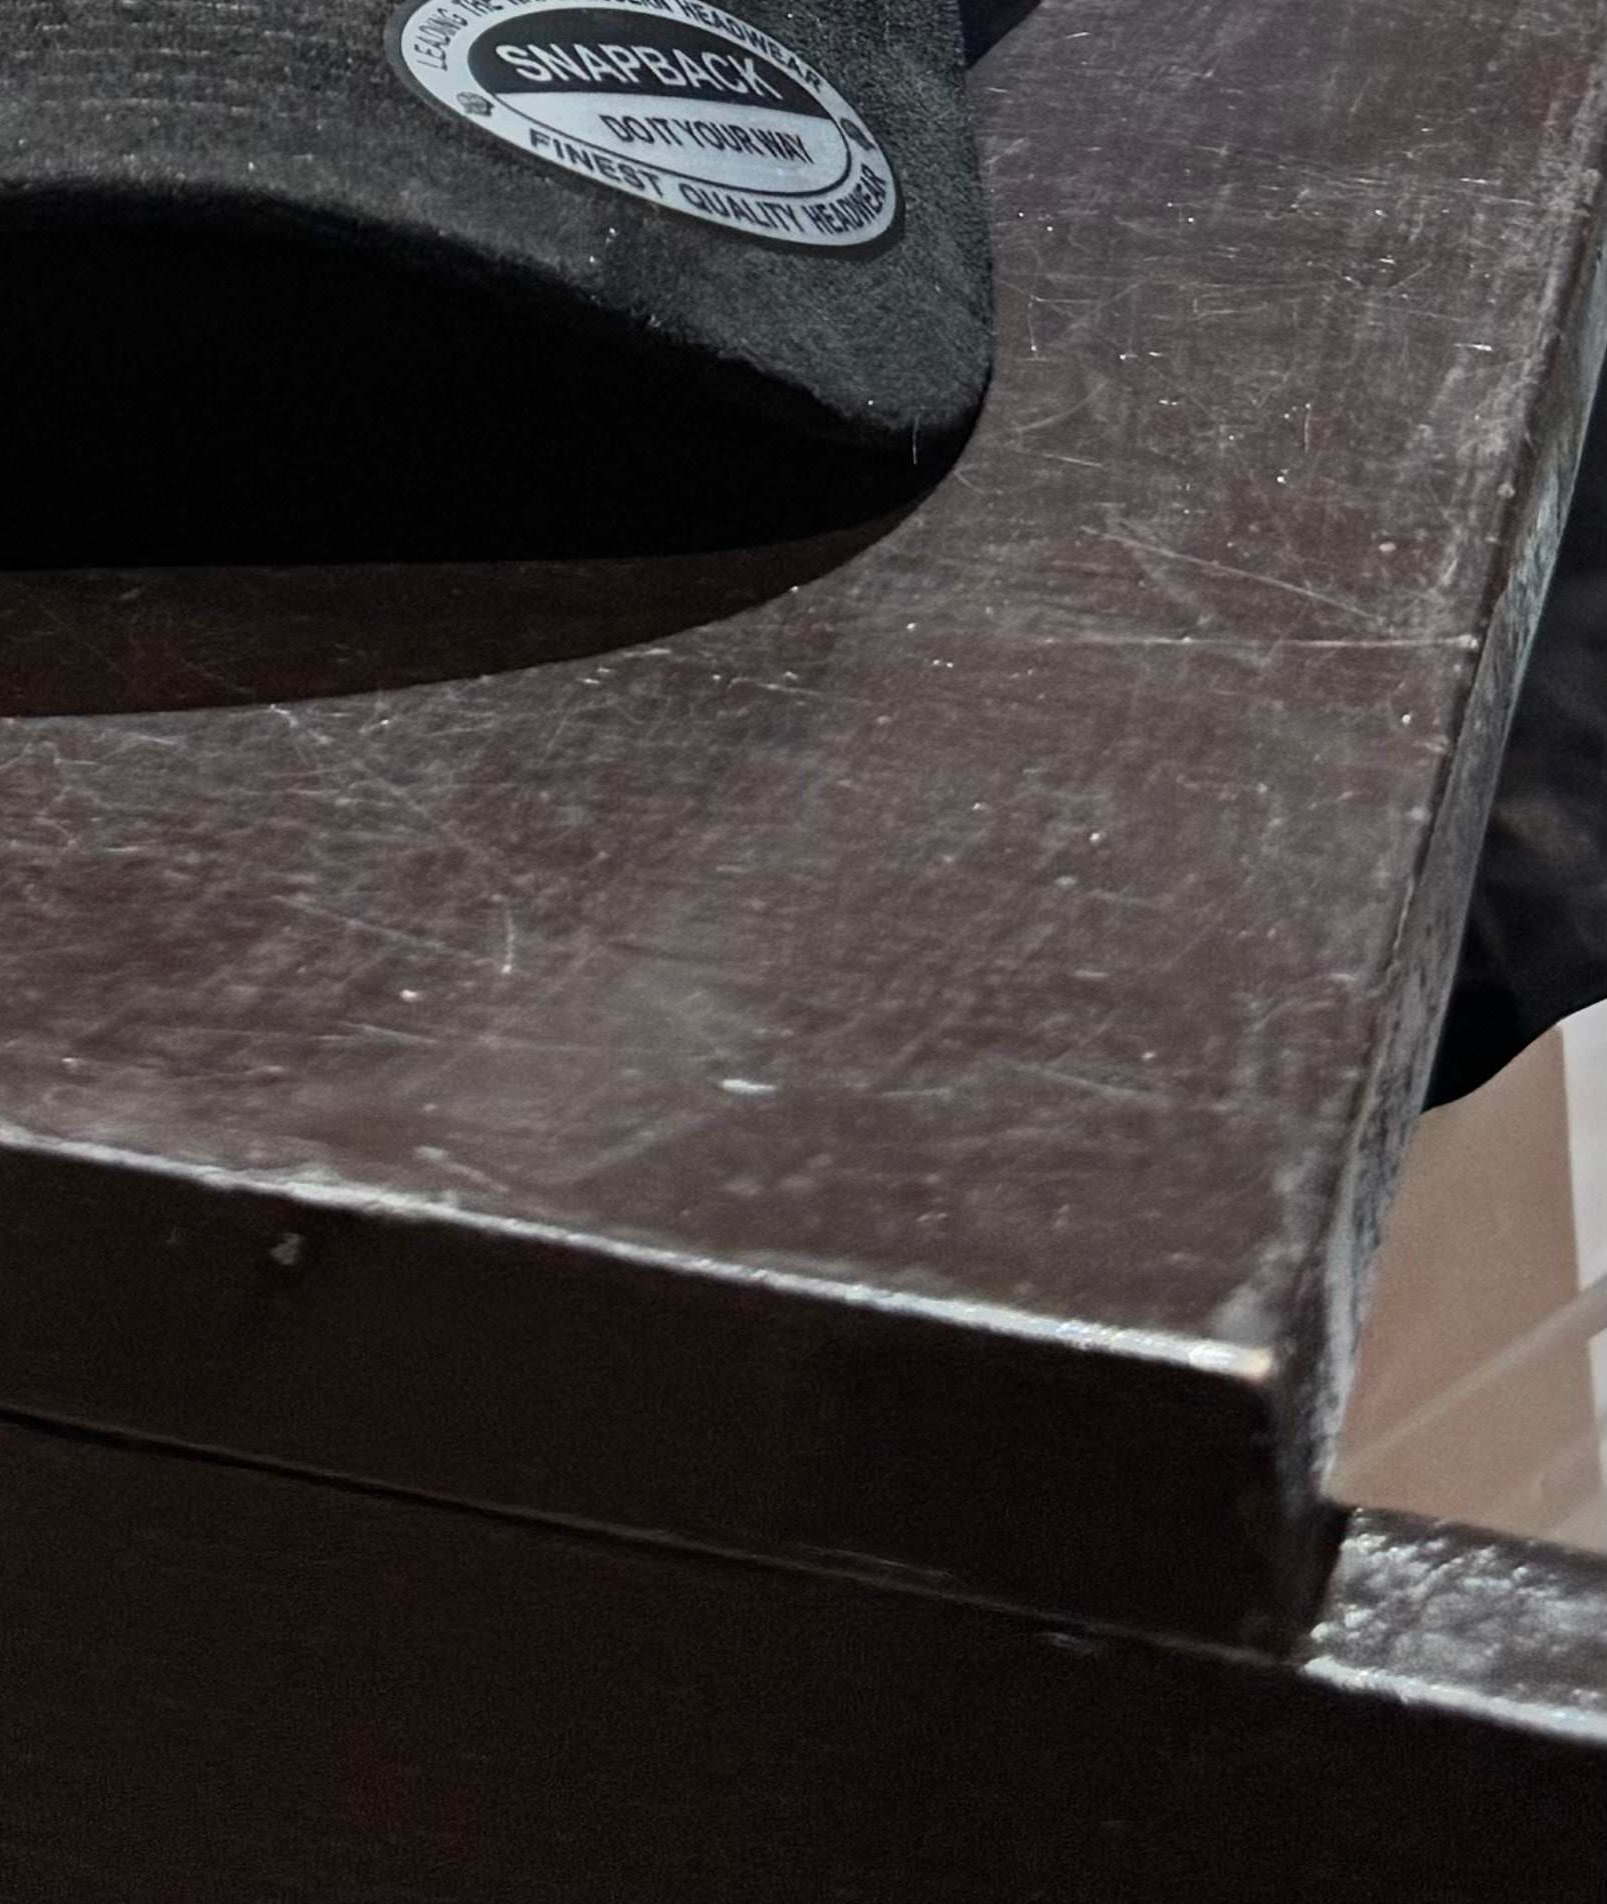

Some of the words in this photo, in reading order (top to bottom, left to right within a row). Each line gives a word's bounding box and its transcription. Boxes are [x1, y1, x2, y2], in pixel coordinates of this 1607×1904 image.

[413, 7, 469, 72] LEADING
[495, 43, 784, 100] SNAPBACK
[598, 114, 652, 144] DO
[649, 117, 683, 147] IT
[675, 119, 762, 157] YOUR
[754, 127, 815, 165] WAY
[527, 128, 664, 198] FINEST
[678, 182, 806, 234] QUALITY
[803, 163, 888, 237] HEADWEAR
